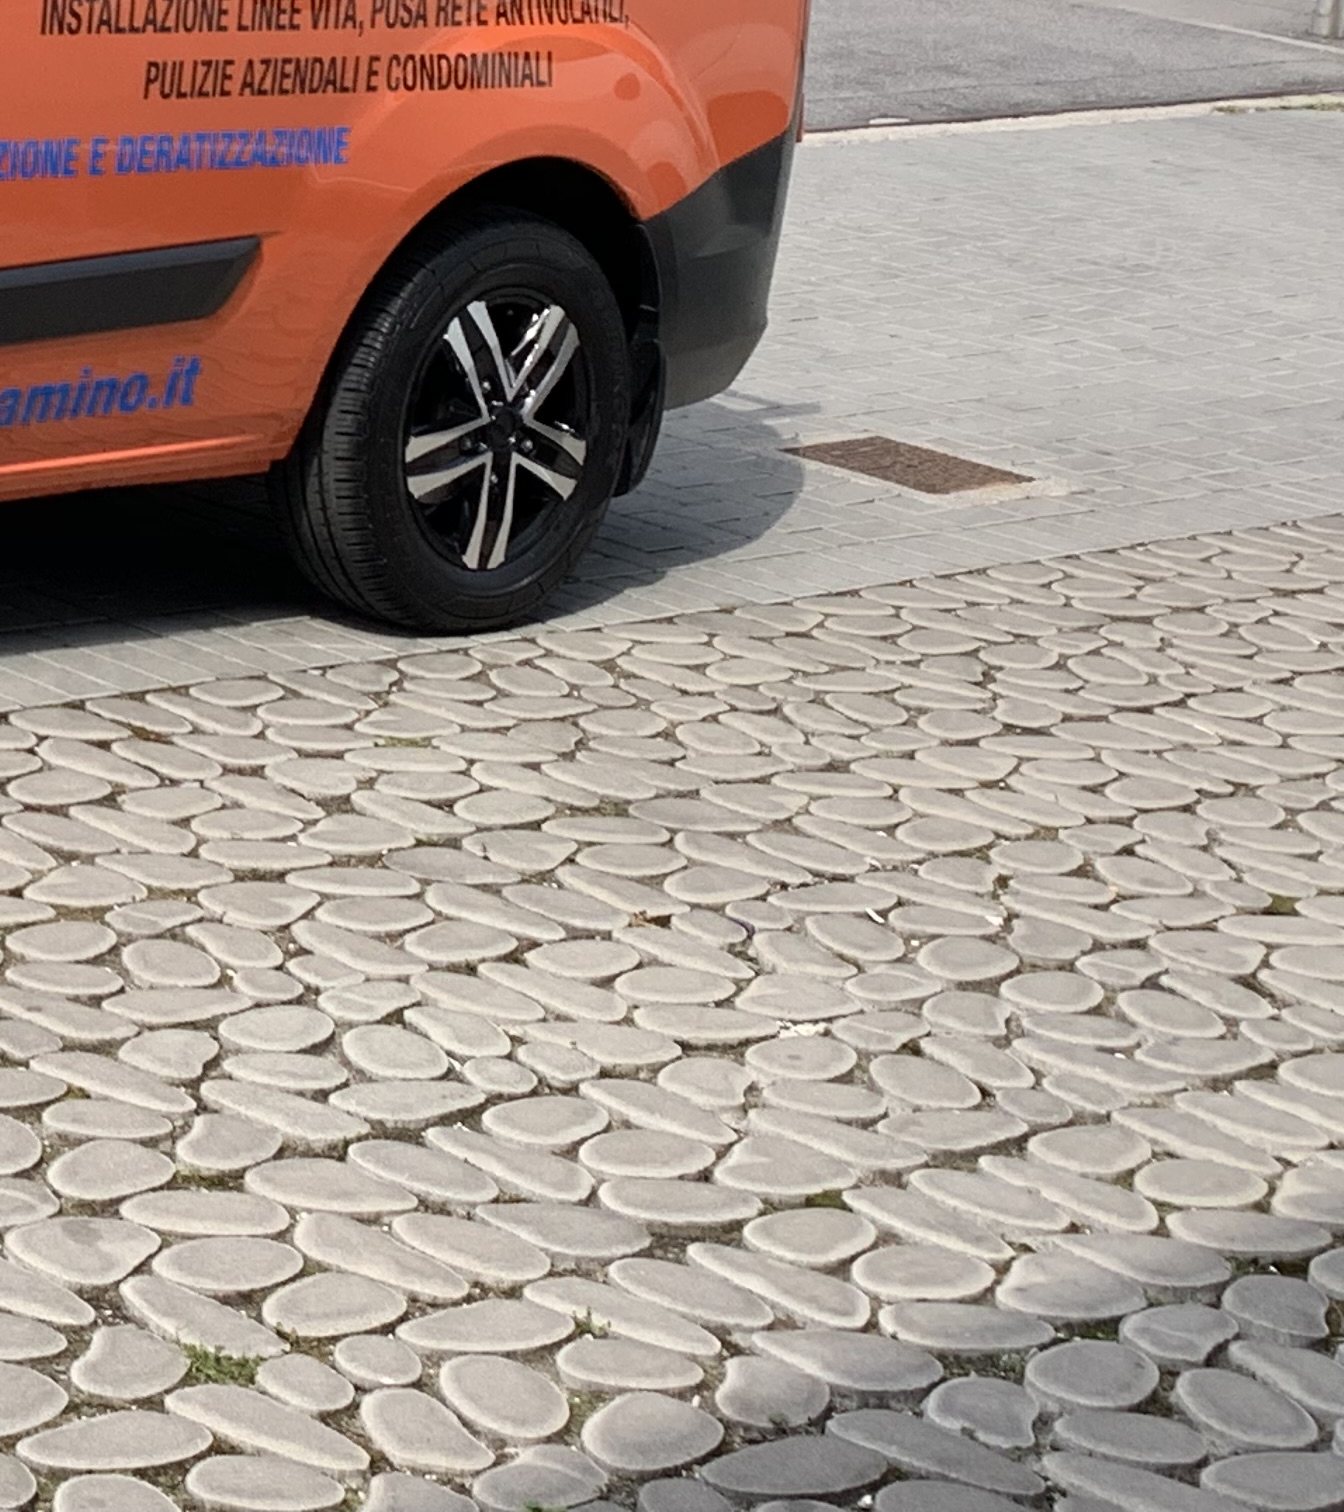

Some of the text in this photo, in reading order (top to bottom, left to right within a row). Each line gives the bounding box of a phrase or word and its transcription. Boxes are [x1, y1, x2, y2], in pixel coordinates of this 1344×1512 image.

[143, 51, 553, 100] PULIZIE AZIENDALI E CONDOMINIALI
[88, 136, 108, 177] E
[115, 125, 353, 175] DERATIZZAZIONE
